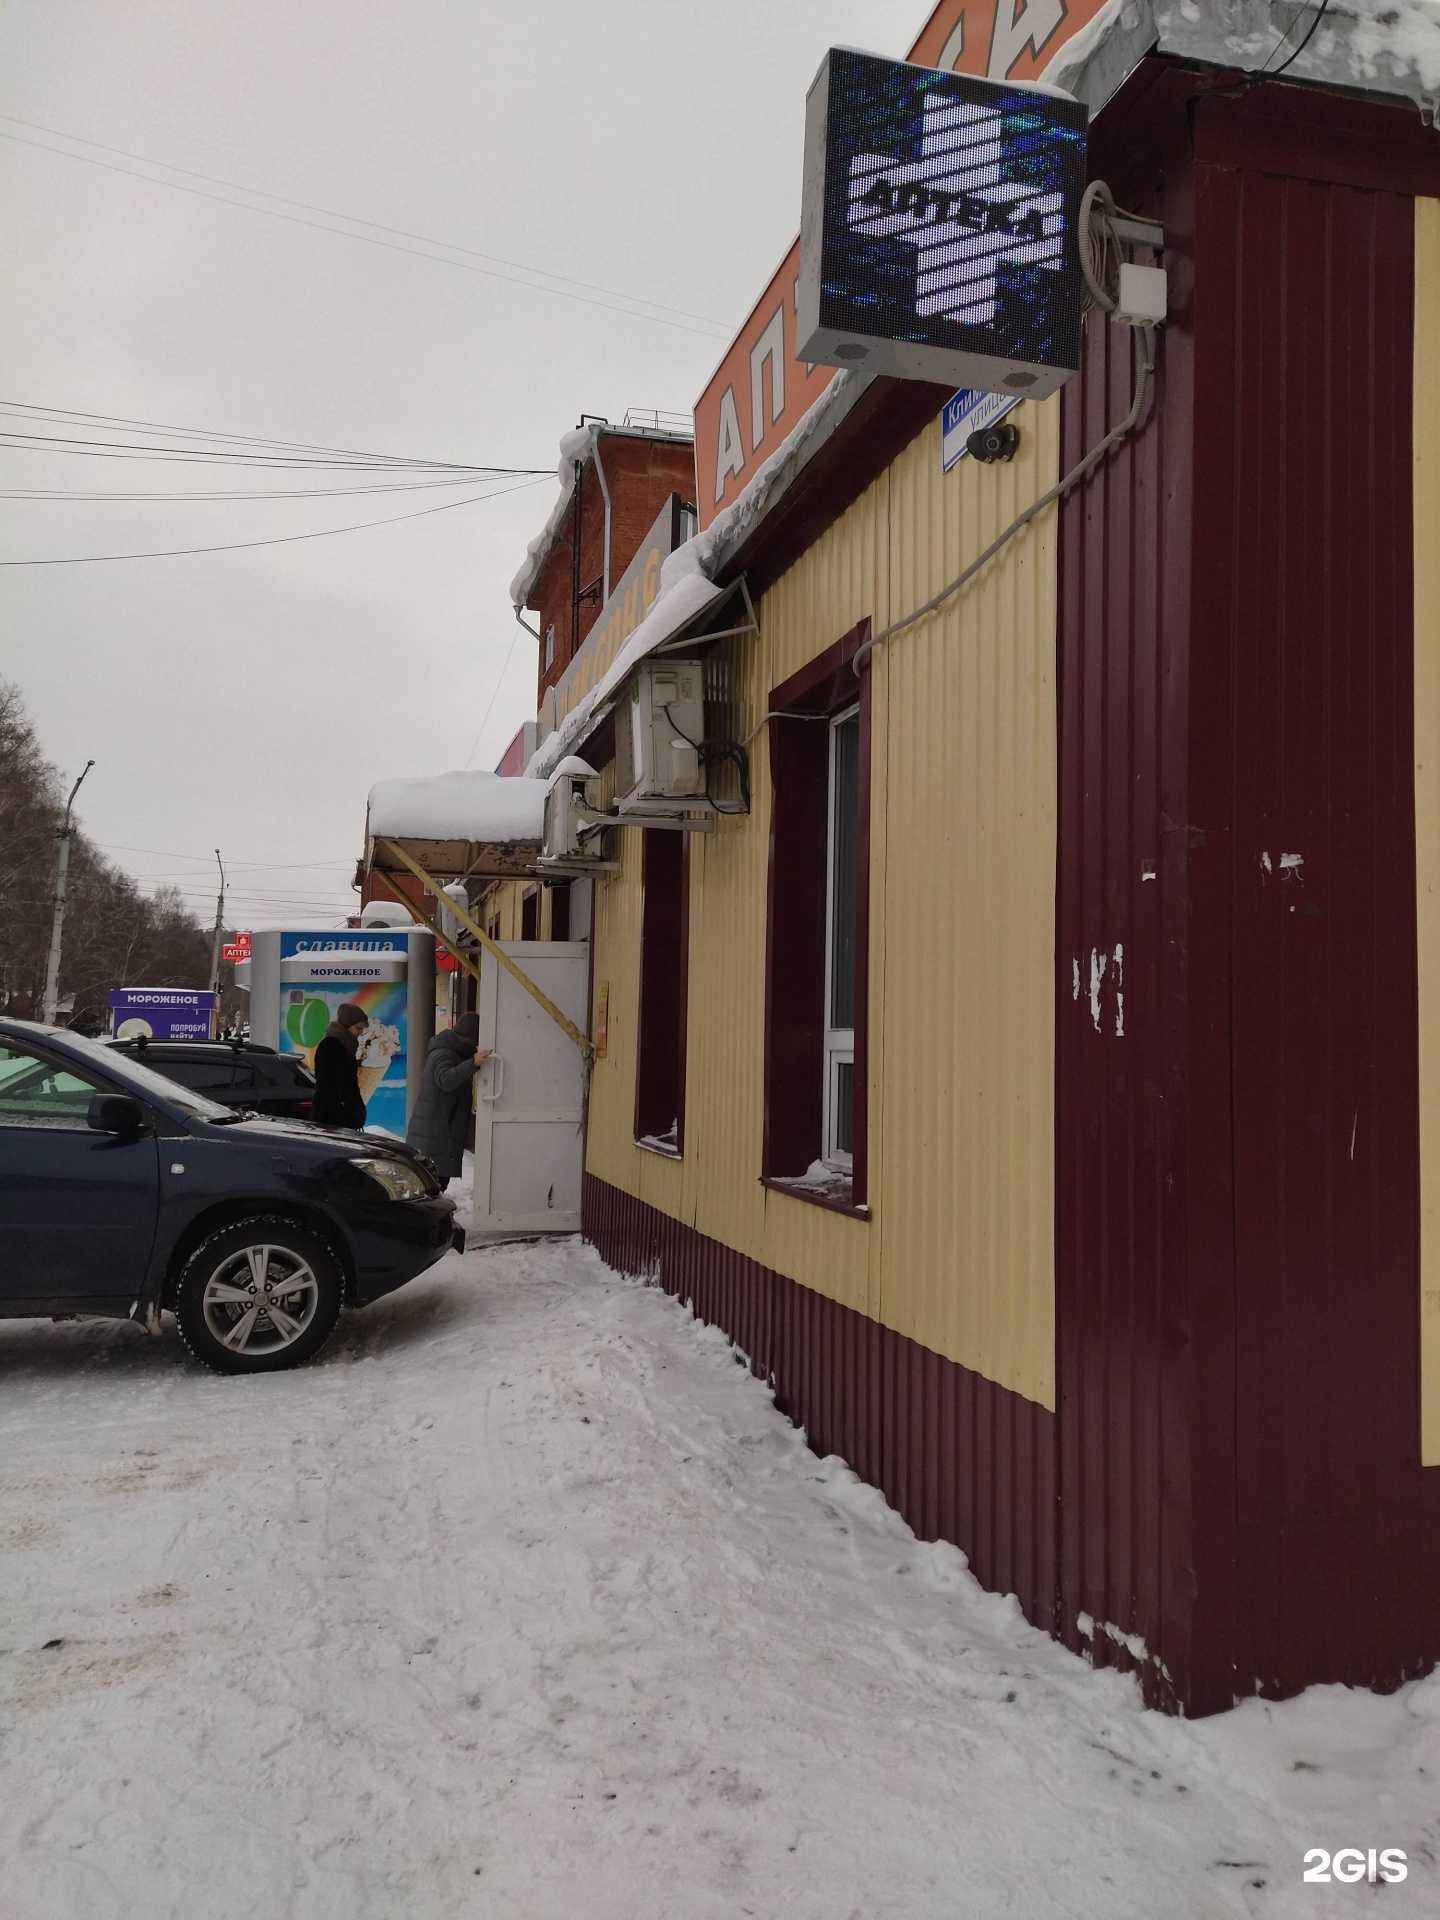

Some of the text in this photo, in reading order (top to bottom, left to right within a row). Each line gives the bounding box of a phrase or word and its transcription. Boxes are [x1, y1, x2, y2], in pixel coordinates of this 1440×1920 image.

[863, 179, 1043, 237] АПТЕКА
[226, 949, 251, 957] АПТЕ
[310, 968, 382, 976] МОРОЖЕНОЕ
[127, 995, 199, 1004] МОРОЖЕНОЕ
[170, 1022, 207, 1033] ПОПРОБУЙ
